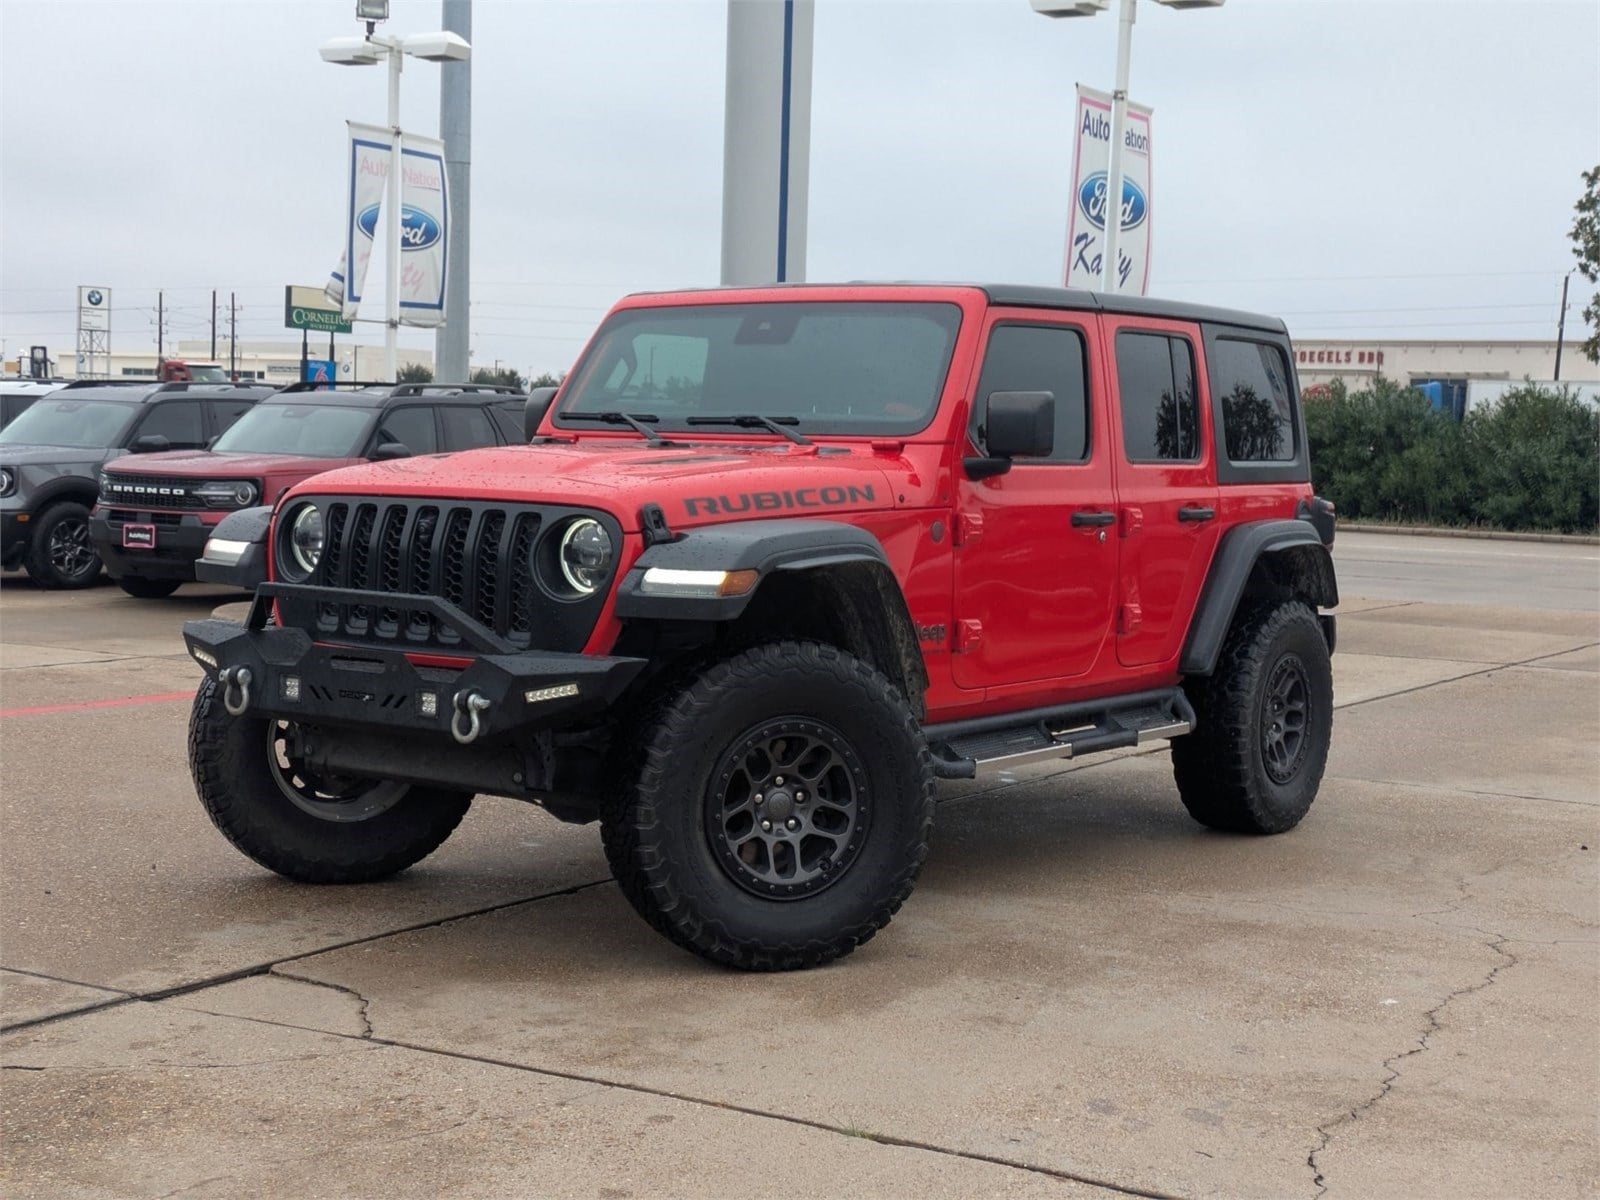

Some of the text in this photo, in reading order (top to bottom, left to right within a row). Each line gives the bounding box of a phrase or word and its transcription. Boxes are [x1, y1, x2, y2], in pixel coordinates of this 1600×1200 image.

[1082, 109, 1148, 150] Autoation
[1089, 178, 1136, 224] Fd
[1073, 232, 1133, 289] Kay
[113, 485, 185, 495] BRONCO
[684, 485, 875, 517] RUBICON
